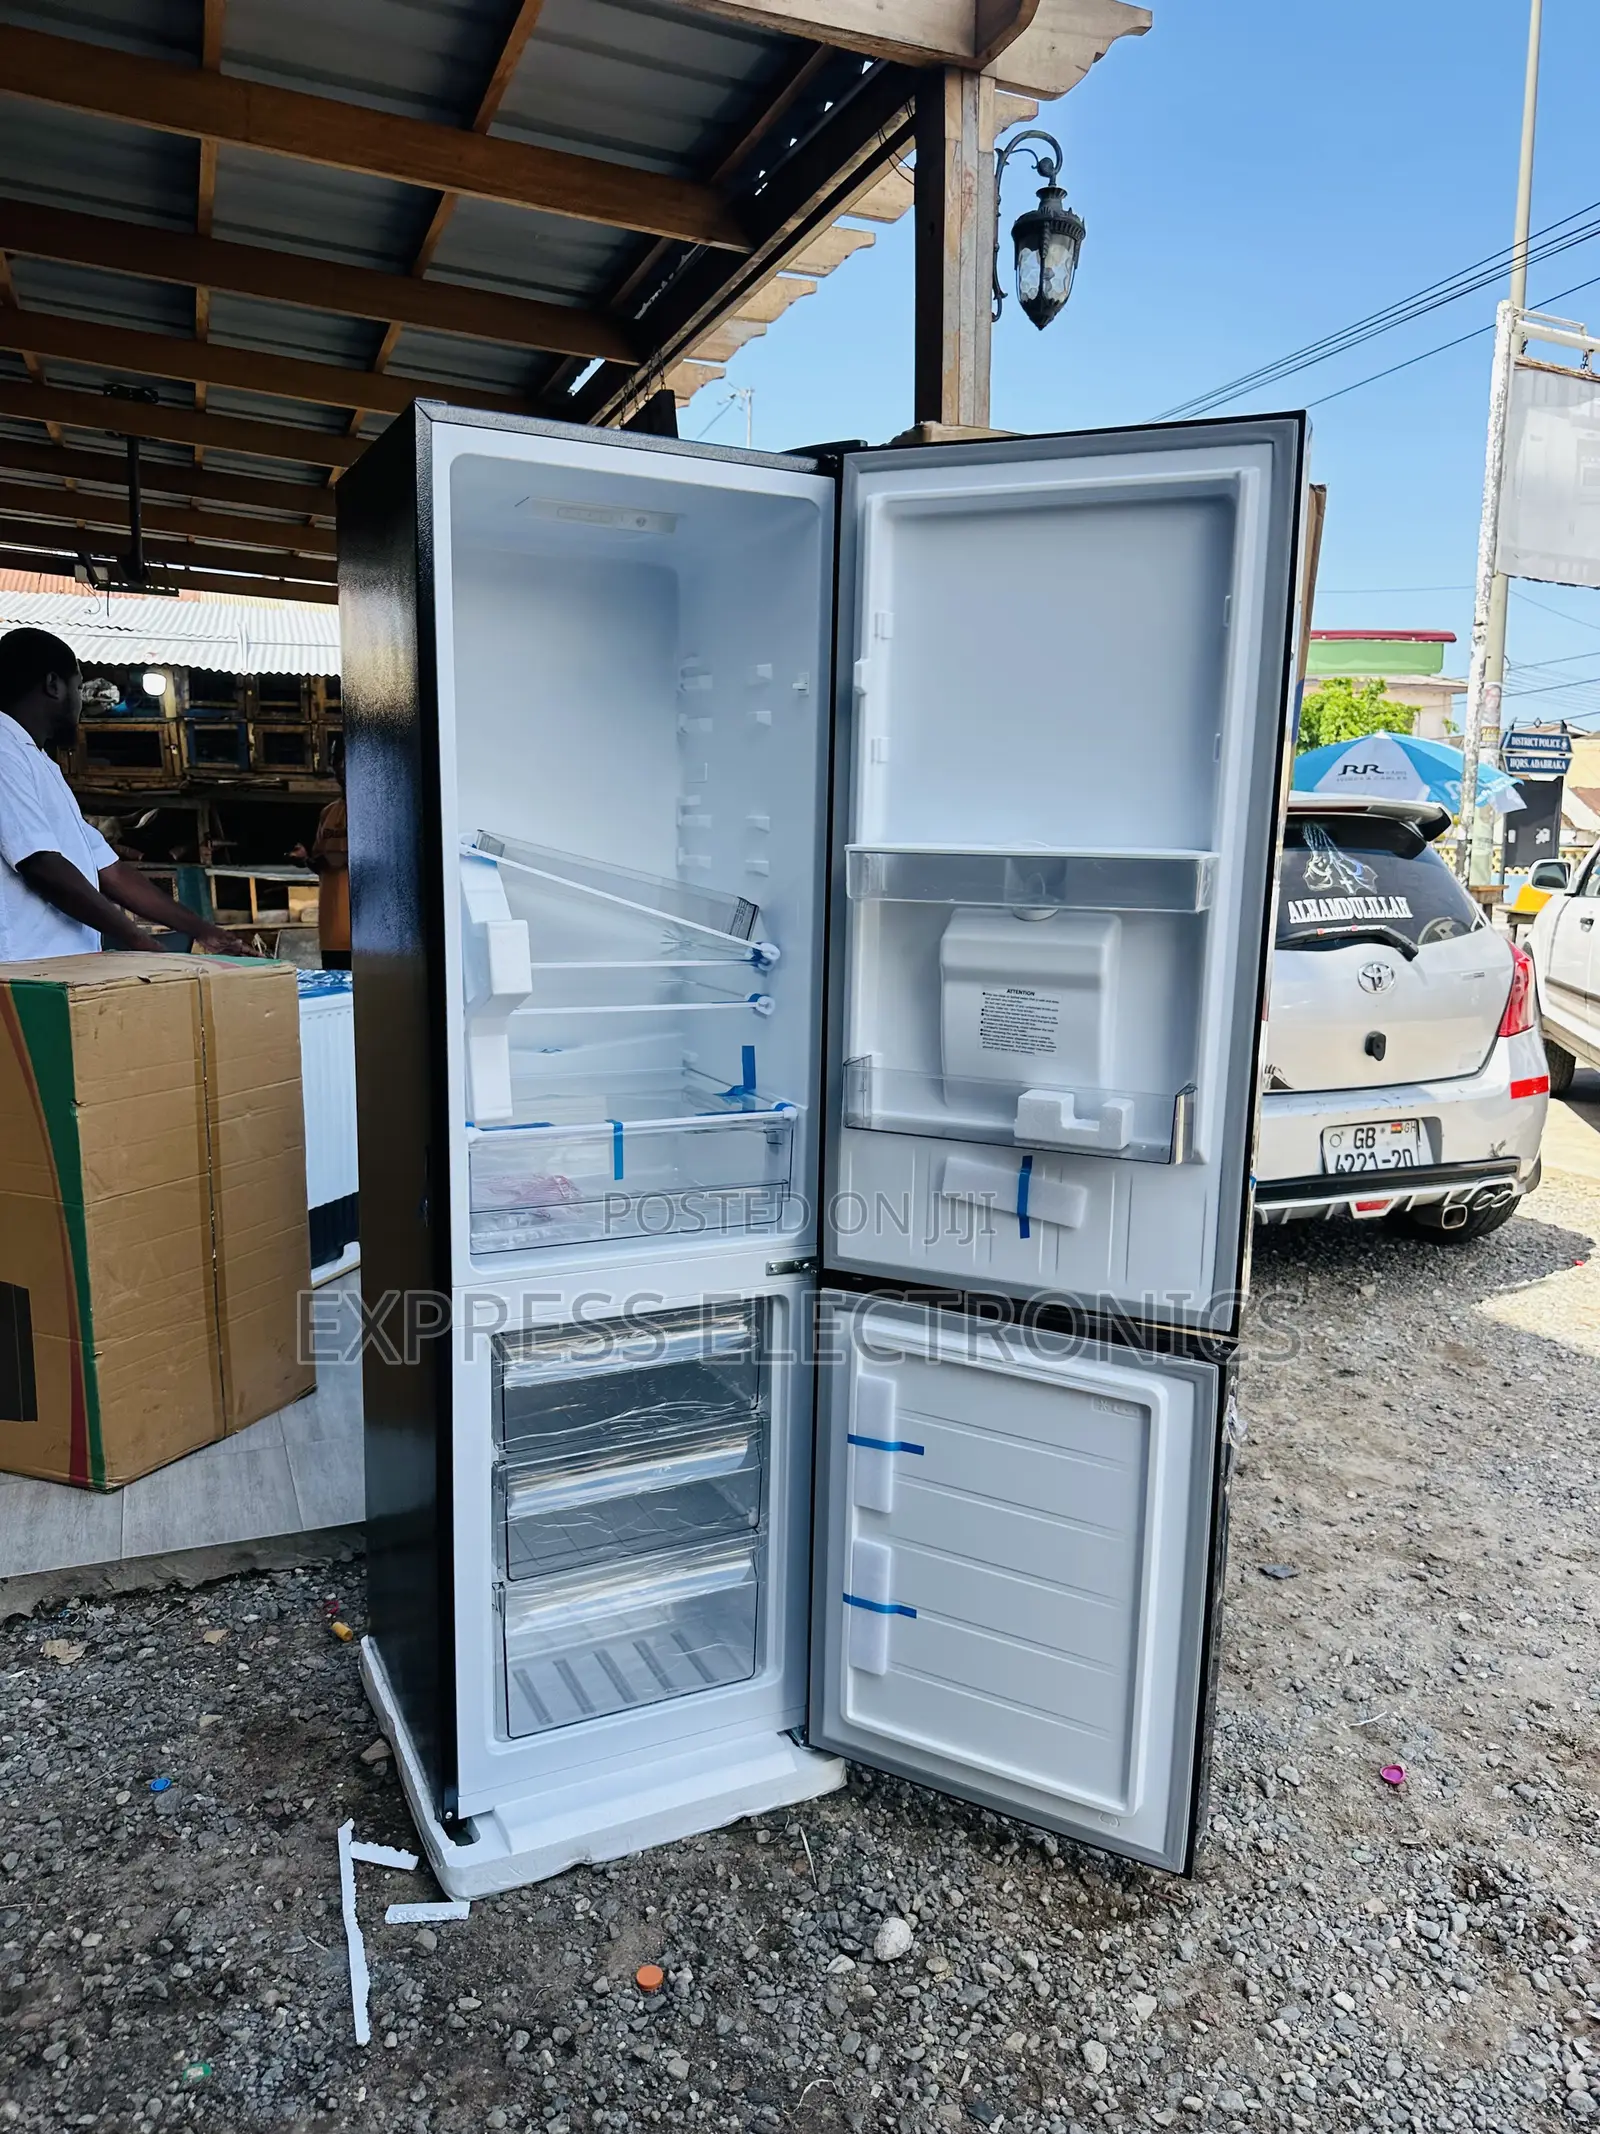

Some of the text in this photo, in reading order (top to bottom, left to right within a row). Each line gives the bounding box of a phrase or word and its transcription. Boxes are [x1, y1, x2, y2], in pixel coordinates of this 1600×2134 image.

[1511, 736, 1561, 749] DISTRICT POLICE
[1288, 896, 1413, 924] ALHAMDULILLAH
[1006, 988, 1035, 996] ATTENTION
[1353, 1122, 1417, 1149] GB GH
